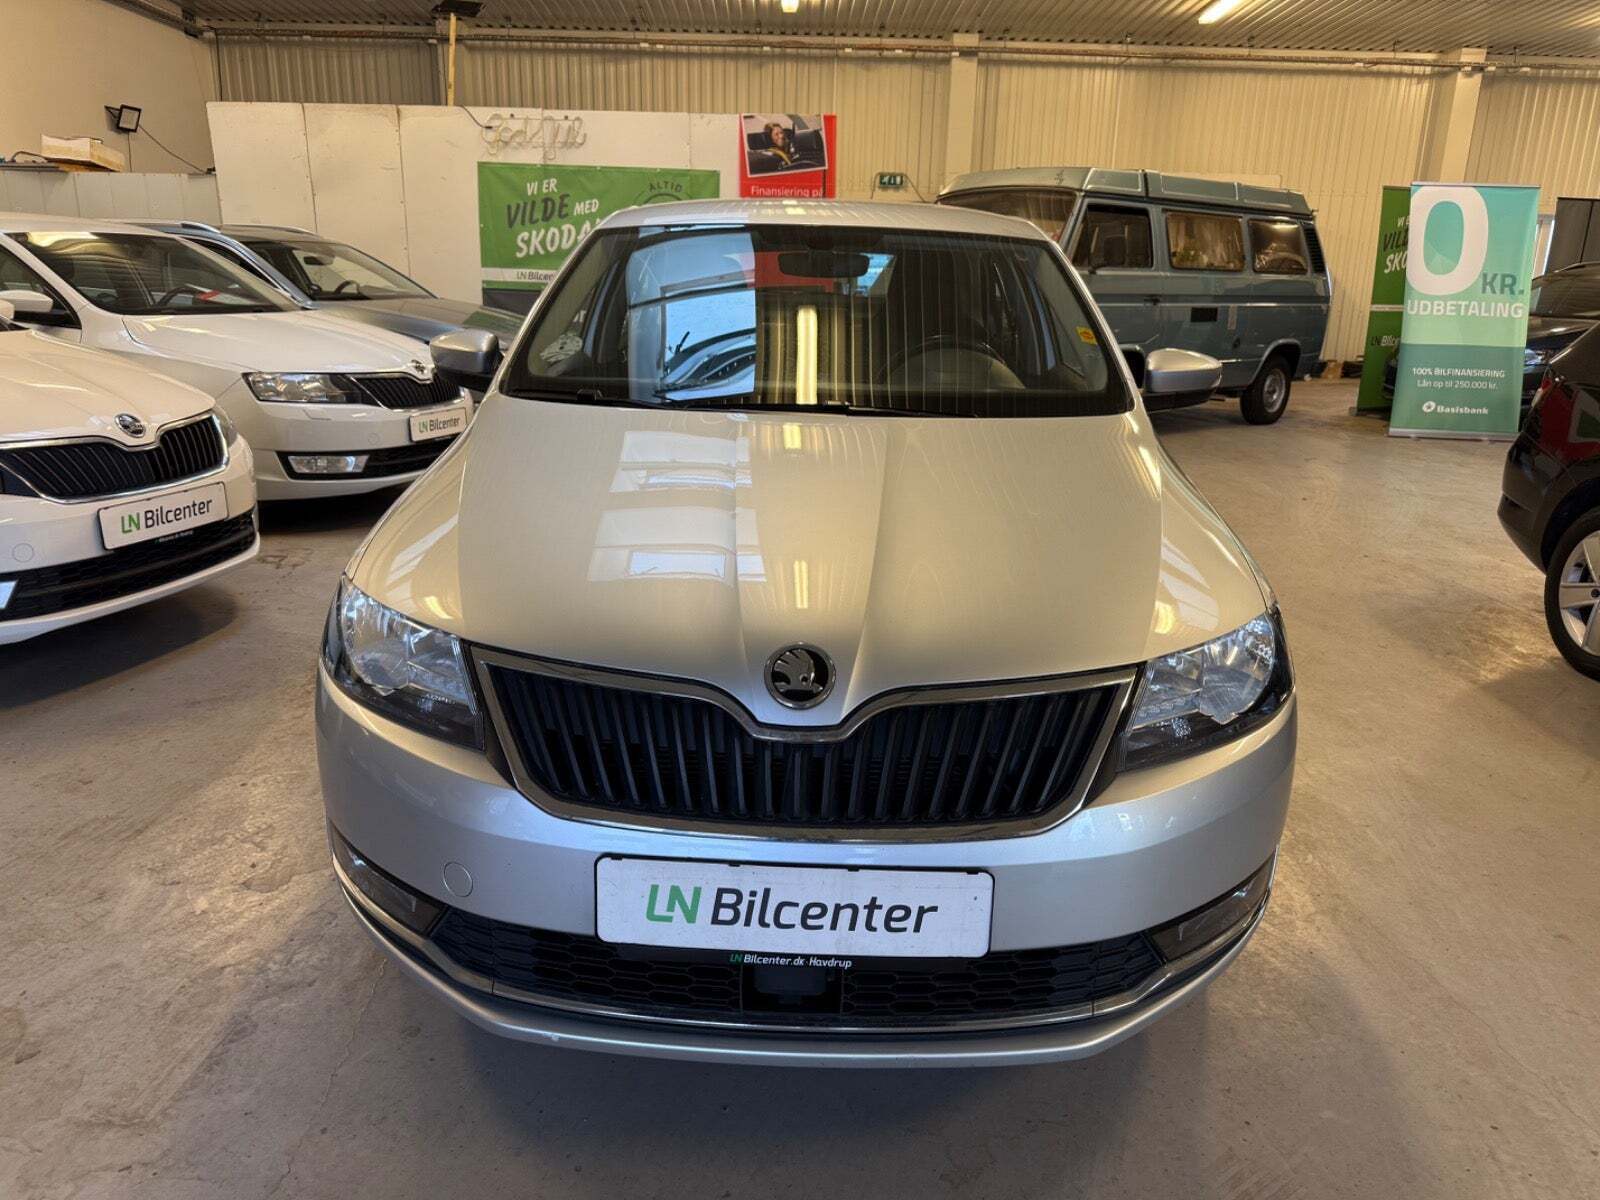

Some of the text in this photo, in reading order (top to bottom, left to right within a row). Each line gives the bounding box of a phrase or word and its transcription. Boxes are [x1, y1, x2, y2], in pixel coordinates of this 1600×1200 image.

[526, 178, 558, 196] VI ER
[751, 185, 810, 198] Finansiering
[506, 193, 599, 229] VILDE MED
[1406, 186, 1525, 296] 0 KR.
[1407, 299, 1524, 318] UDBETALING
[1412, 367, 1505, 378] 100% BILFINANSIERING
[1433, 382, 1444, 390] op
[1454, 380, 1488, 389] 250.000
[1437, 404, 1489, 415] Basisbank
[429, 417, 460, 431] Bilcenter
[121, 499, 213, 534] LN Bilcenter
[645, 884, 939, 933] LN Bilcenter
[730, 953, 742, 963] LN
[809, 957, 853, 969] Havdrup
